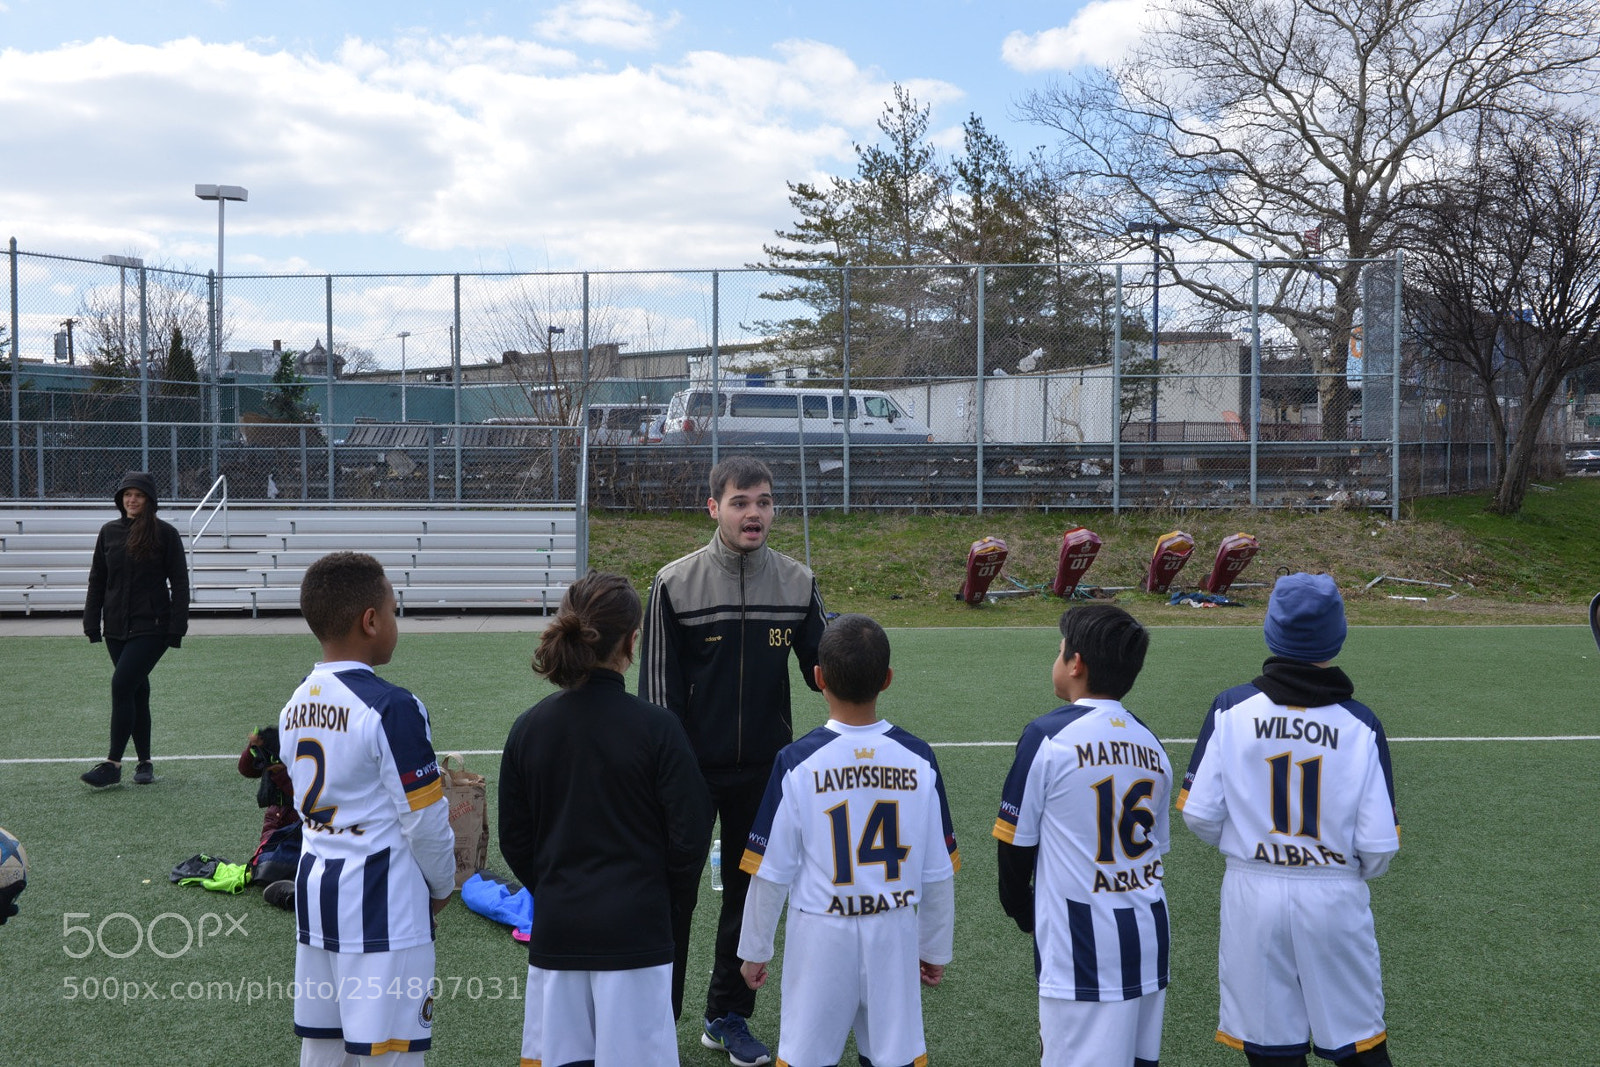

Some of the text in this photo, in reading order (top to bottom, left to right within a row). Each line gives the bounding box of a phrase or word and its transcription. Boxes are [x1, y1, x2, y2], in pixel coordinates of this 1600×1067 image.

[978, 565, 996, 577] 01
[1070, 558, 1088, 570] 01
[769, 628, 792, 647] 83-C
[1252, 716, 1340, 750] WILSON
[1074, 740, 1165, 775] MARTINEZ
[295, 737, 339, 826] 2
[812, 765, 919, 794] LAVEYSSIERES
[1264, 750, 1323, 841] 11
[1089, 774, 1156, 865] 16
[823, 799, 912, 887] 14
[1253, 842, 1321, 867] ALBA
[826, 893, 890, 916] ALBA
